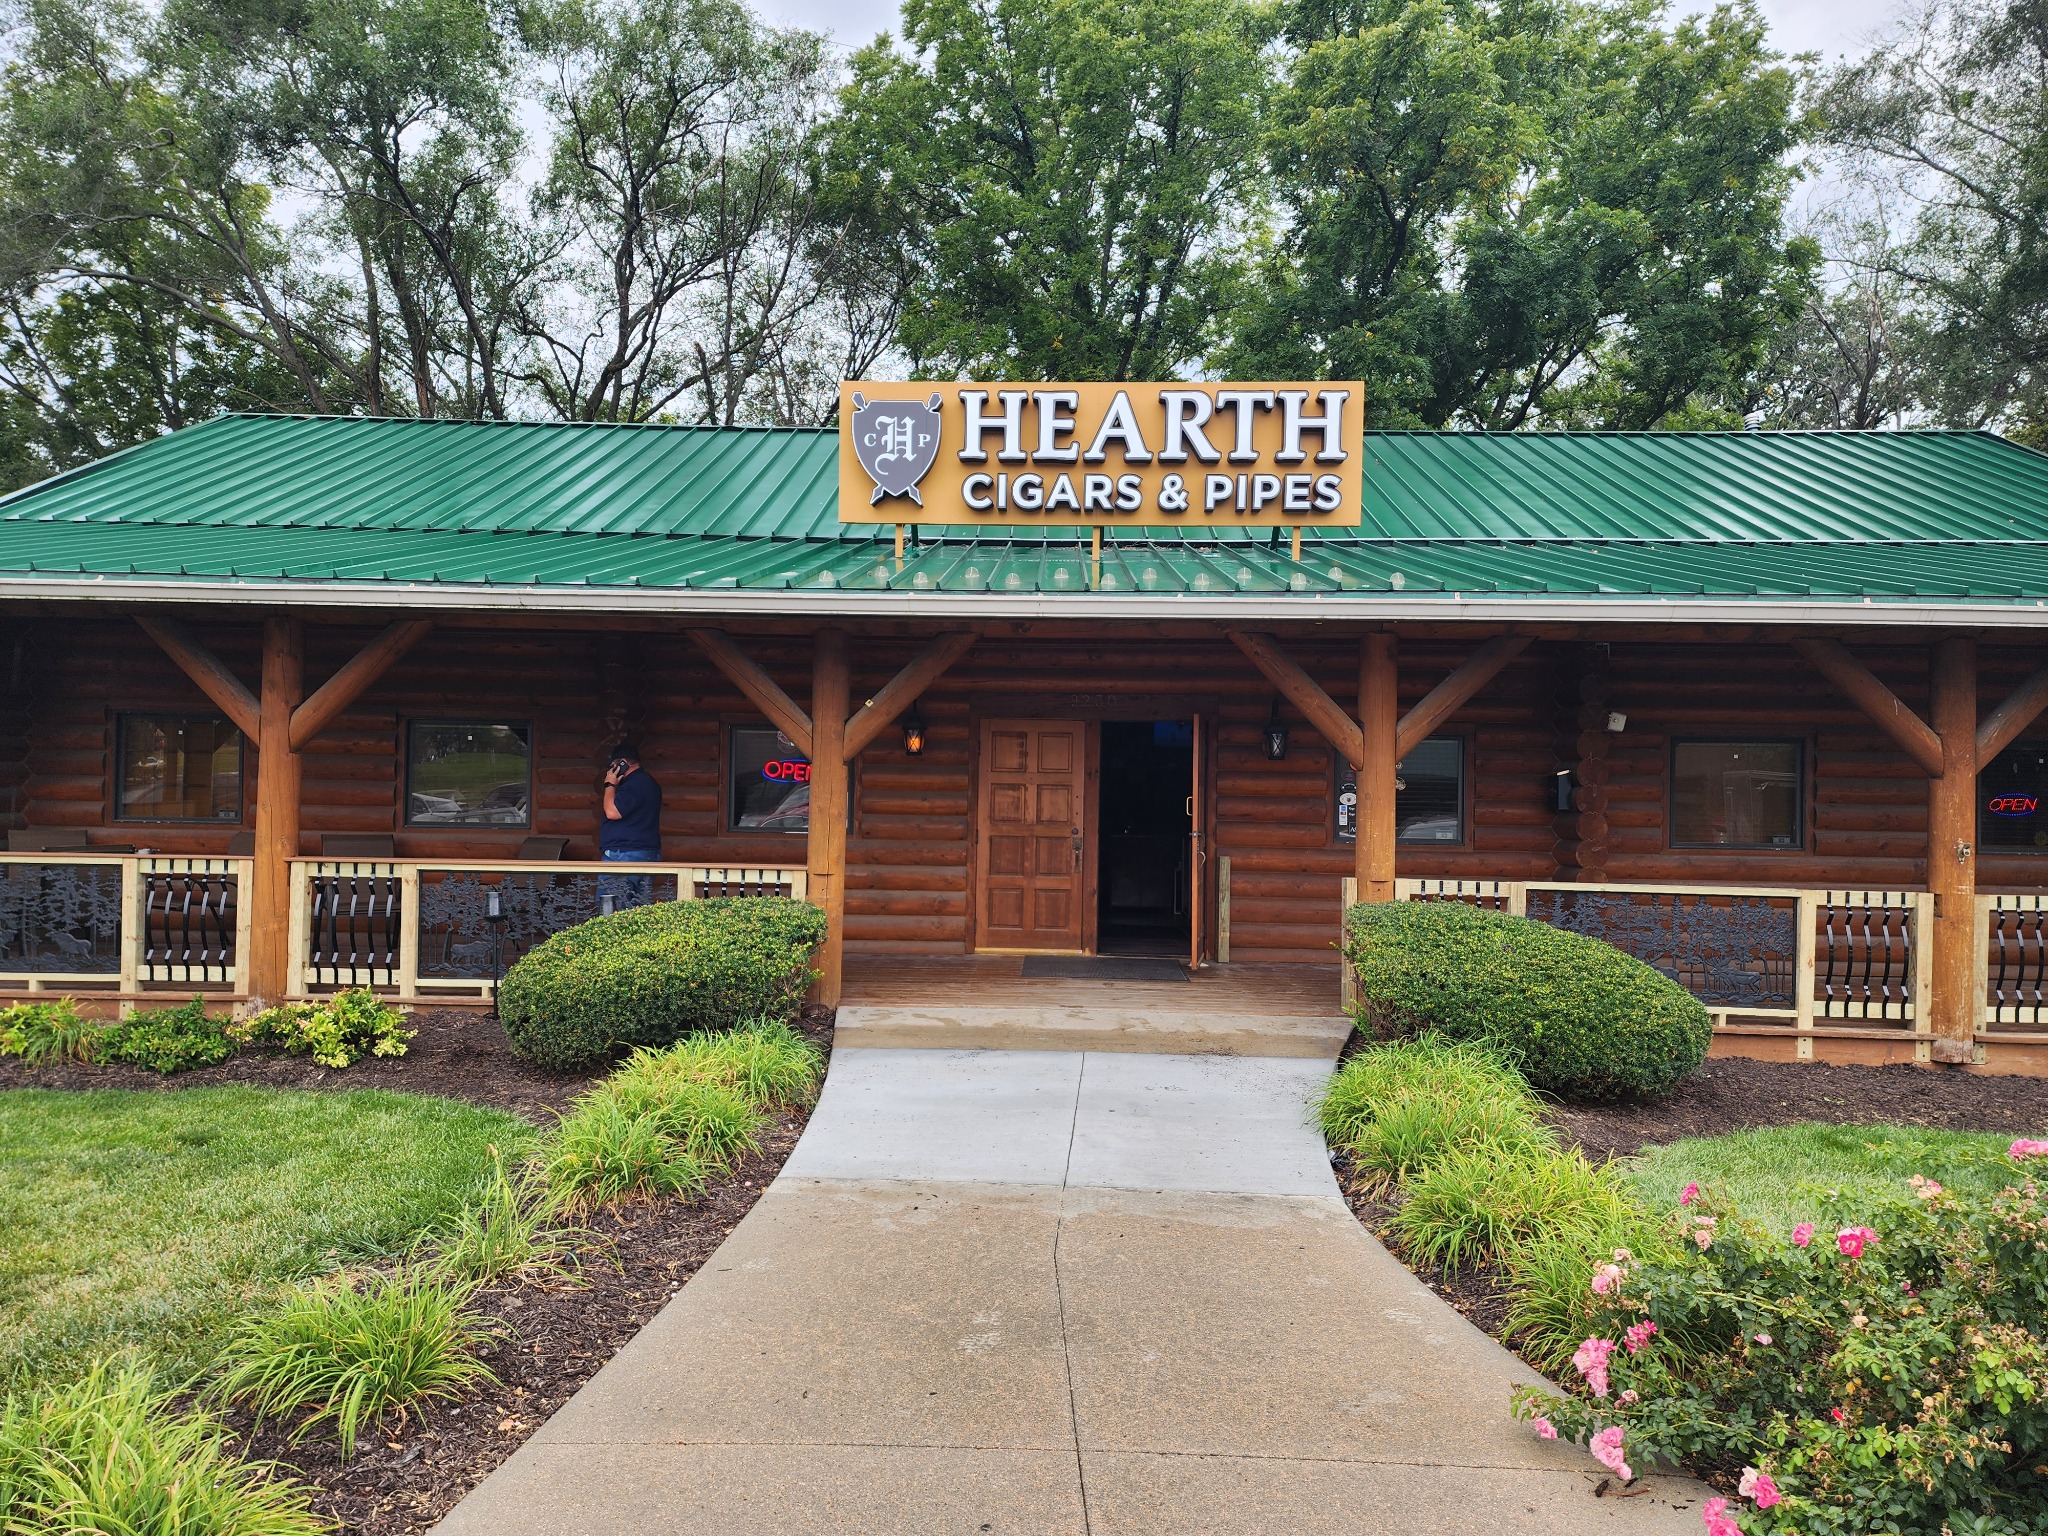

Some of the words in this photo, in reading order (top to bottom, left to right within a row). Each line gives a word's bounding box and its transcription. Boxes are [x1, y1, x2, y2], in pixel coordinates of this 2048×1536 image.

[957, 389, 1350, 464] HEARTH
[864, 433, 876, 447] C
[918, 433, 931, 448] P
[961, 473, 1144, 512] CIGARS
[1157, 473, 1190, 512] &
[1204, 473, 1343, 513] PIPES
[1988, 797, 2038, 812] OPEN
